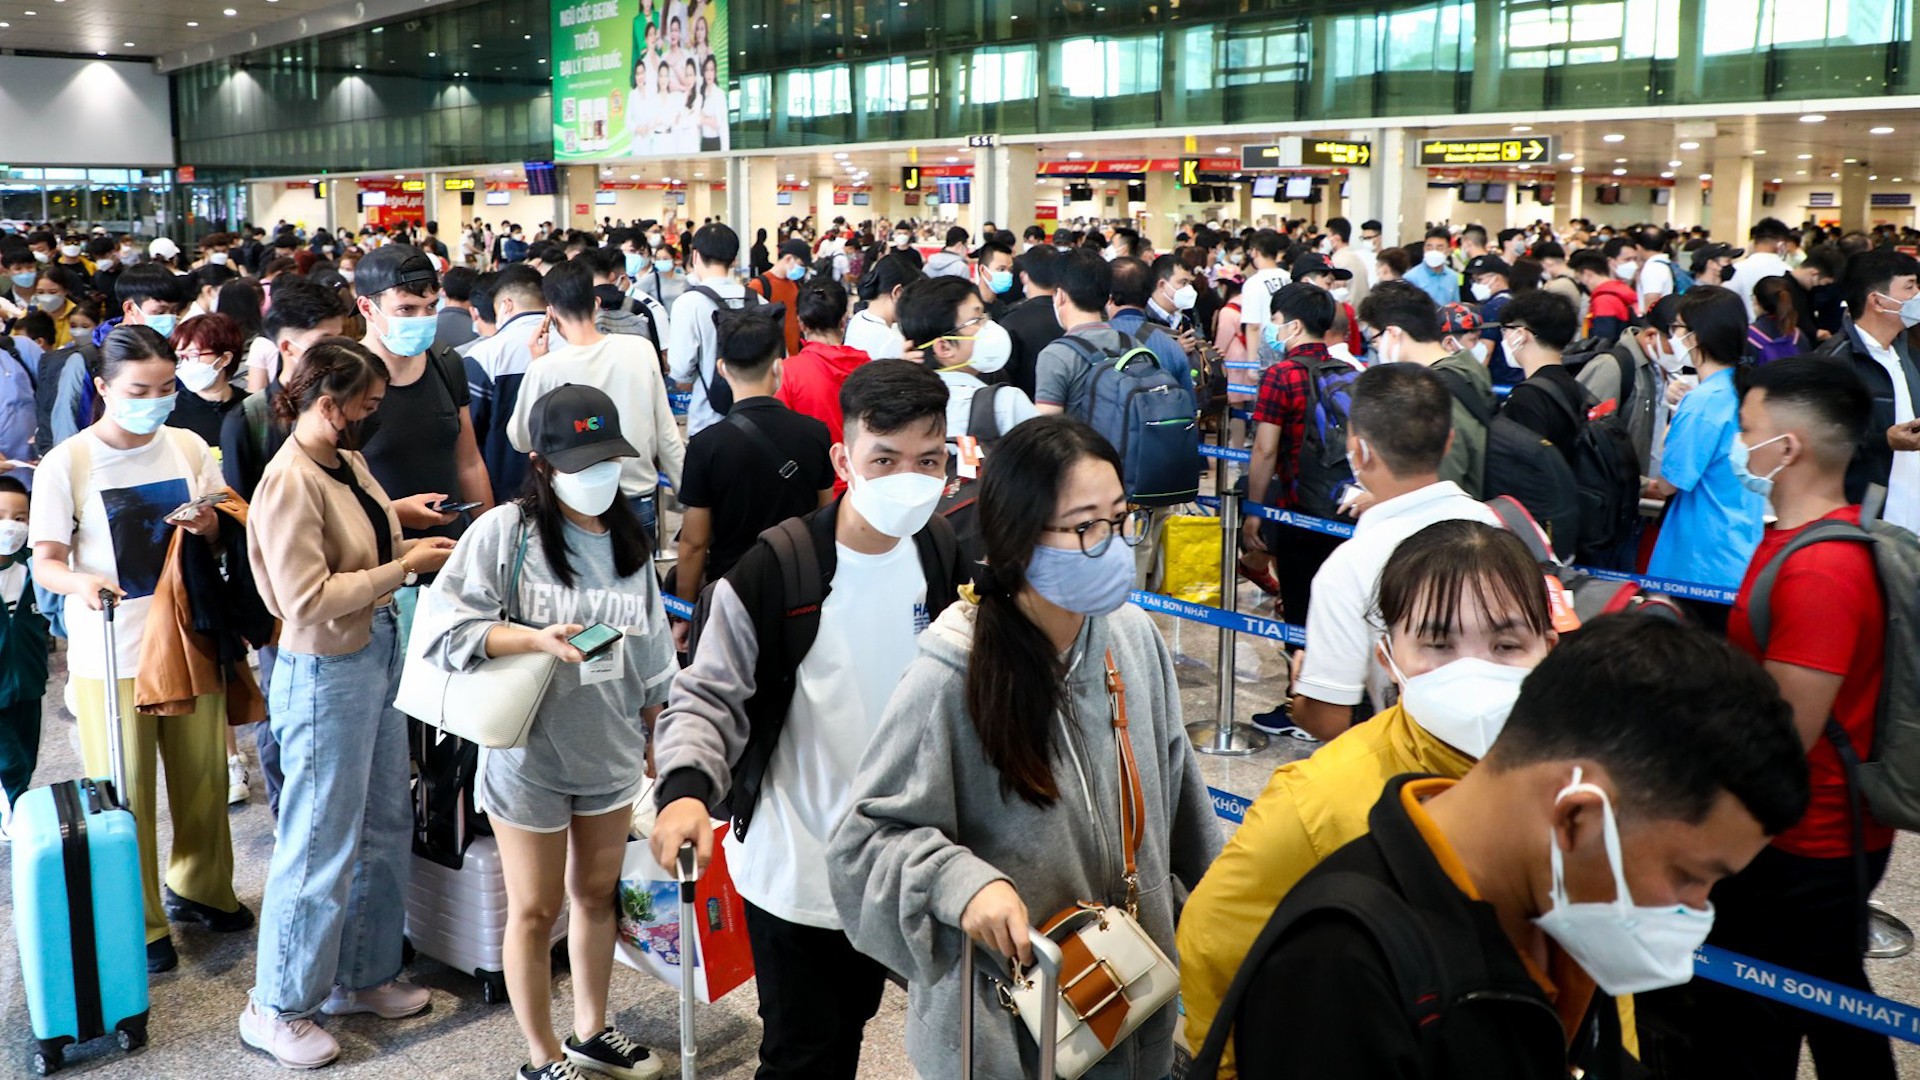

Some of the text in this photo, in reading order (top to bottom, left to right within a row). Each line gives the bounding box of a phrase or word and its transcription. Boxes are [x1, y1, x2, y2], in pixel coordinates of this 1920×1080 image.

[905, 168, 918, 190] J
[1183, 160, 1198, 185] K
[1263, 506, 1293, 524] TIA
[1638, 578, 1661, 591] TAN
[1662, 582, 1688, 595] SON
[1689, 586, 1722, 599] NHAT
[586, 588, 650, 635] YORK
[787, 604, 817, 617] Lenovo
[1130, 591, 1142, 602] TẾ
[1143, 594, 1161, 608] TÂN
[1162, 599, 1183, 612] SƠN
[1243, 617, 1283, 638] TIA
[1732, 961, 1777, 989] TAN
[1782, 977, 1833, 1006] SON
[1839, 995, 1906, 1028] NHAT
